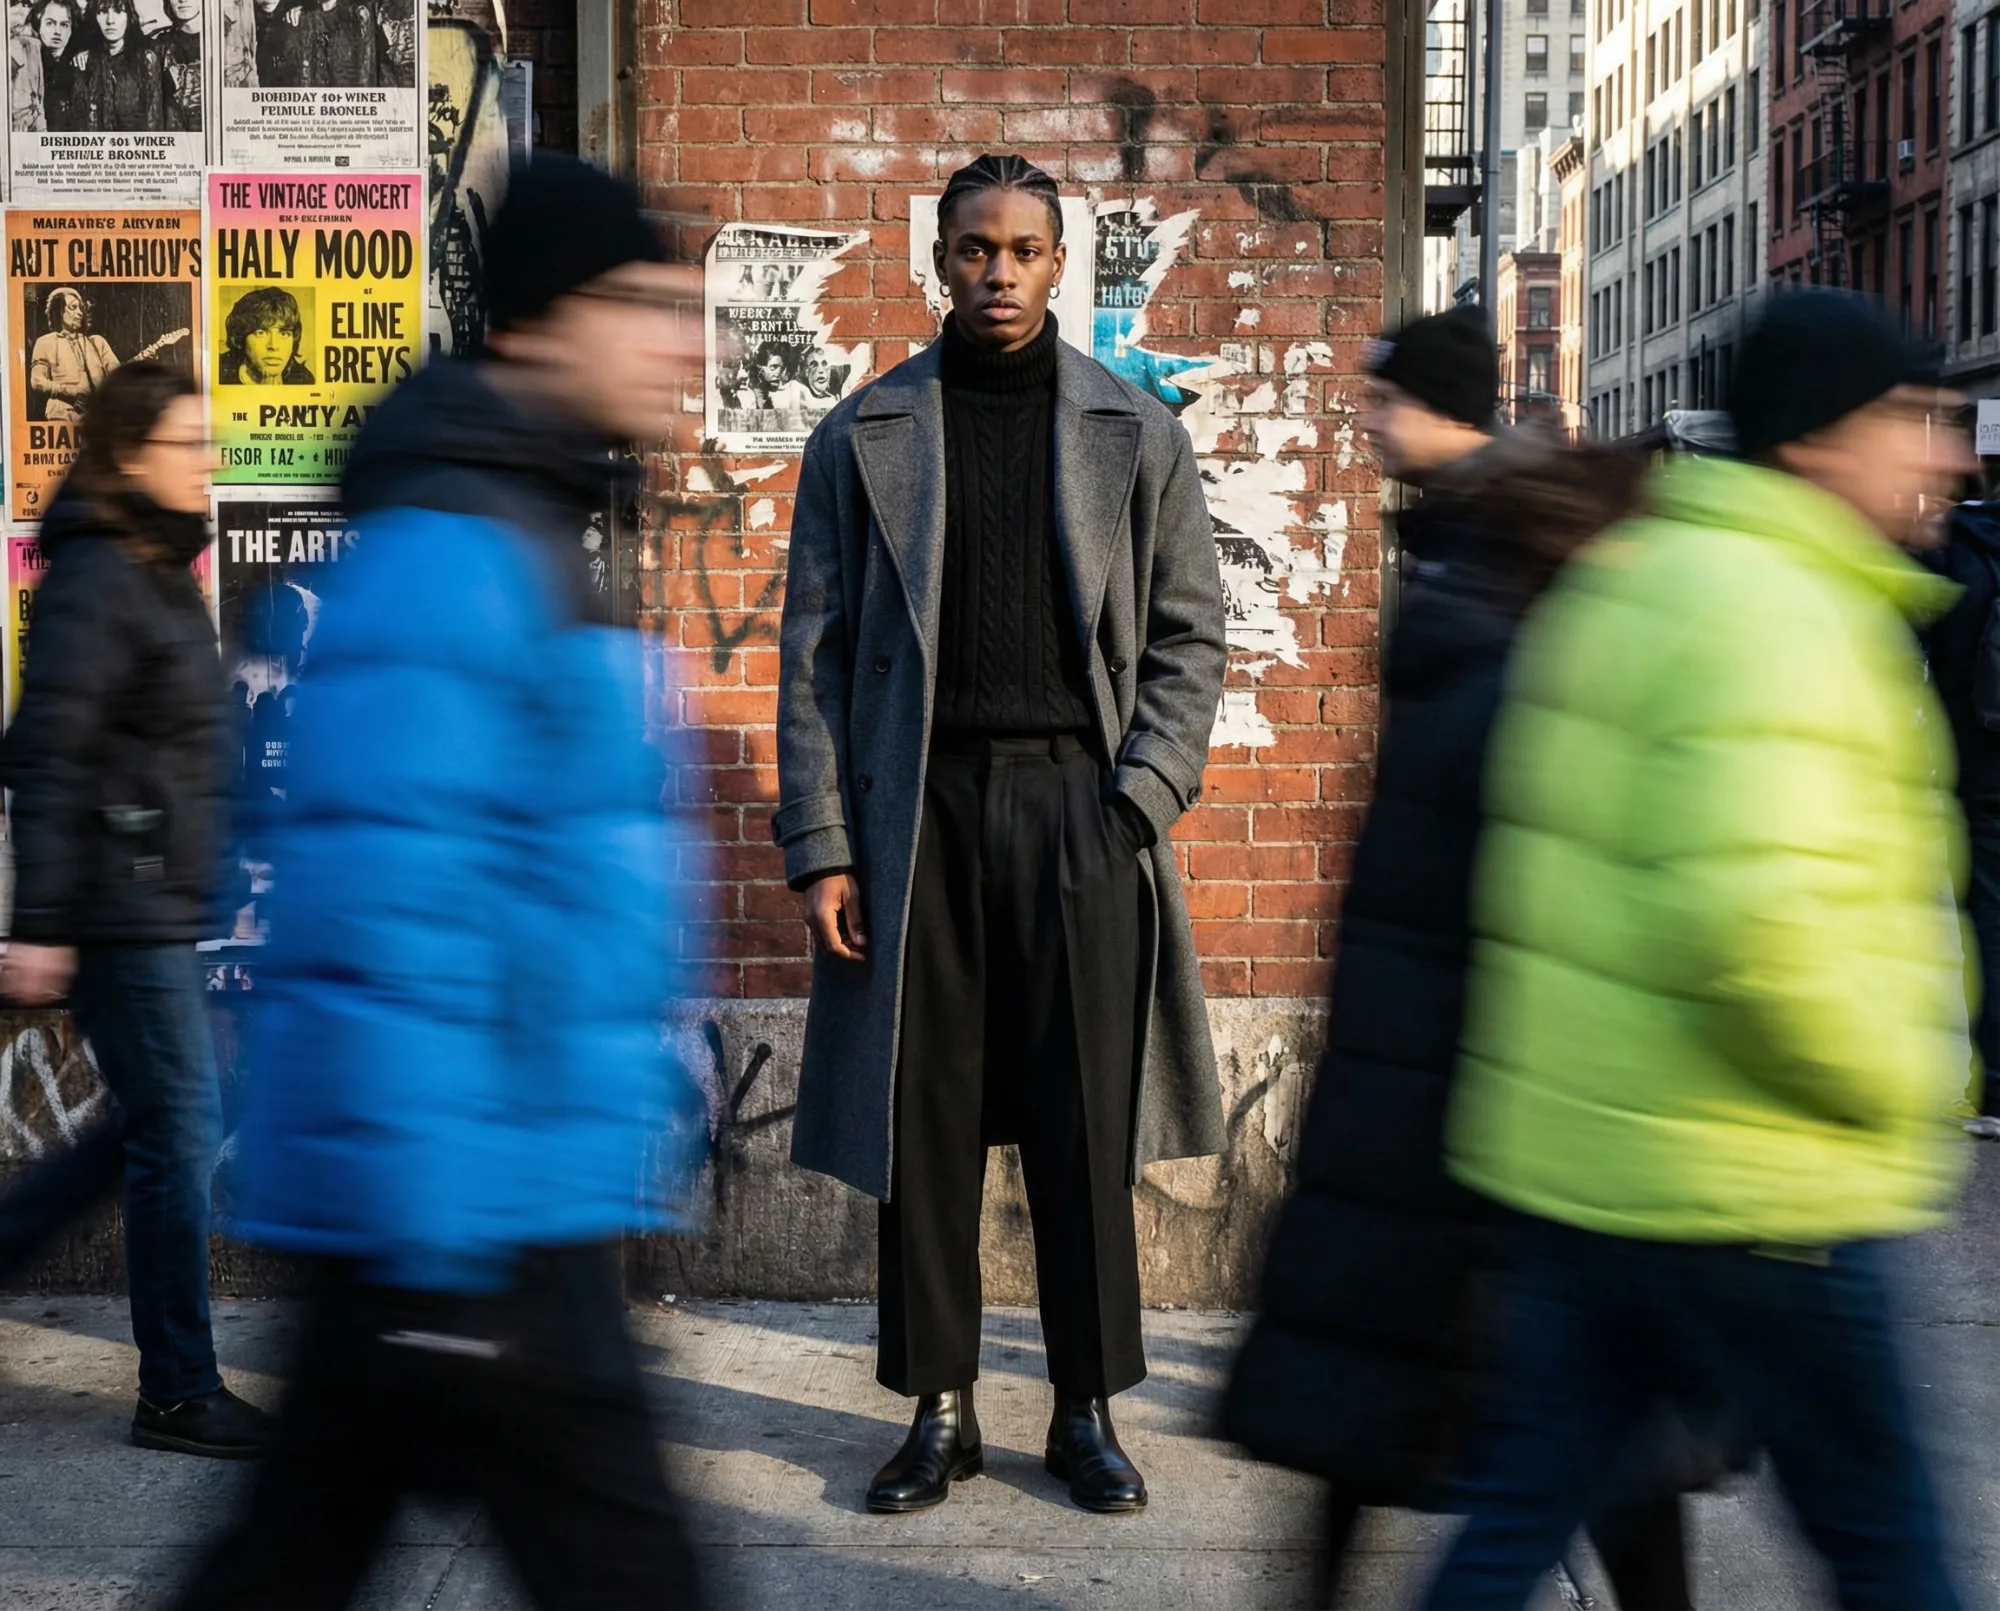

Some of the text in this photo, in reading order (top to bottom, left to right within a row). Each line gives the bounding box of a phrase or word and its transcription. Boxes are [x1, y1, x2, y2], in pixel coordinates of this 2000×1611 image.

[219, 183, 411, 209] THE VINTAGE CONCERT
[218, 229, 413, 279] HALY MOOD
[331, 302, 405, 339] ELINE
[324, 346, 412, 384] BREYS
[227, 530, 281, 563] THE
